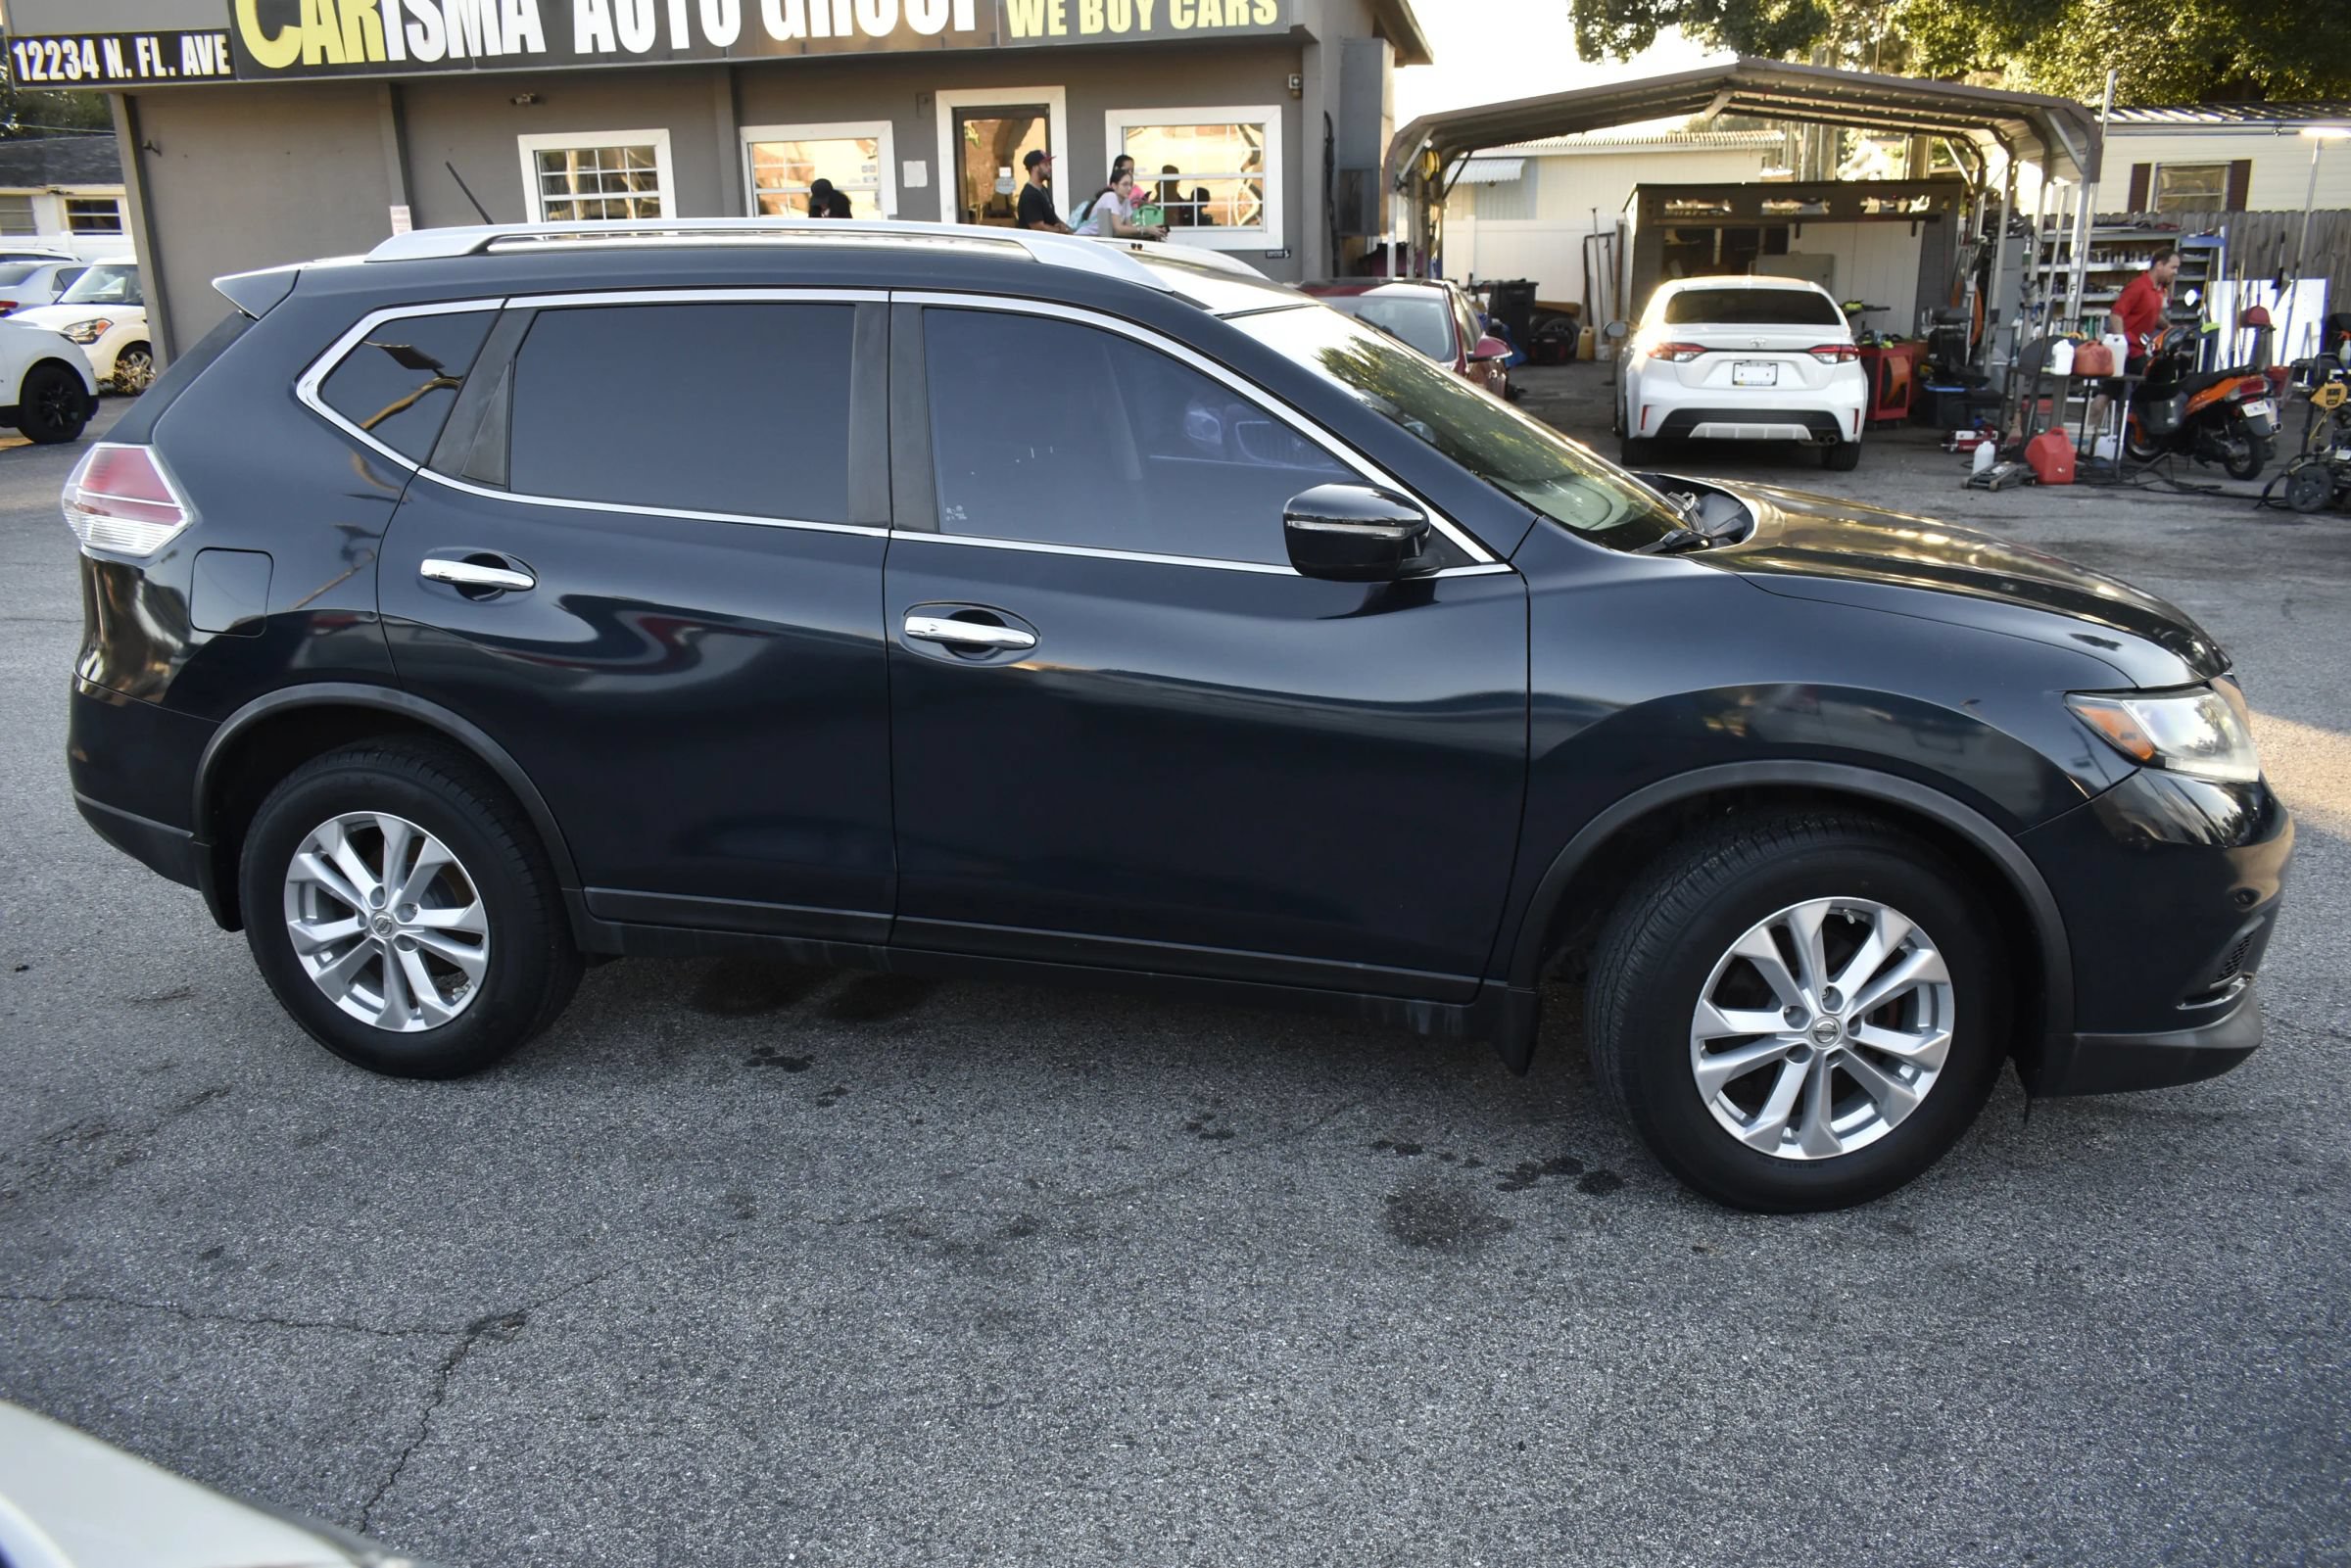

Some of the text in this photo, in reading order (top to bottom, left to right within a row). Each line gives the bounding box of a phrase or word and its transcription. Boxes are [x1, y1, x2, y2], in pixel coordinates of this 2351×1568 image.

[235, 0, 547, 69] CARISMA
[1006, 0, 1068, 38] WE
[1080, 0, 1154, 34] BUY
[1170, 0, 1278, 30] CARS
[13, 34, 231, 81] 12234 N. FL. AVE
